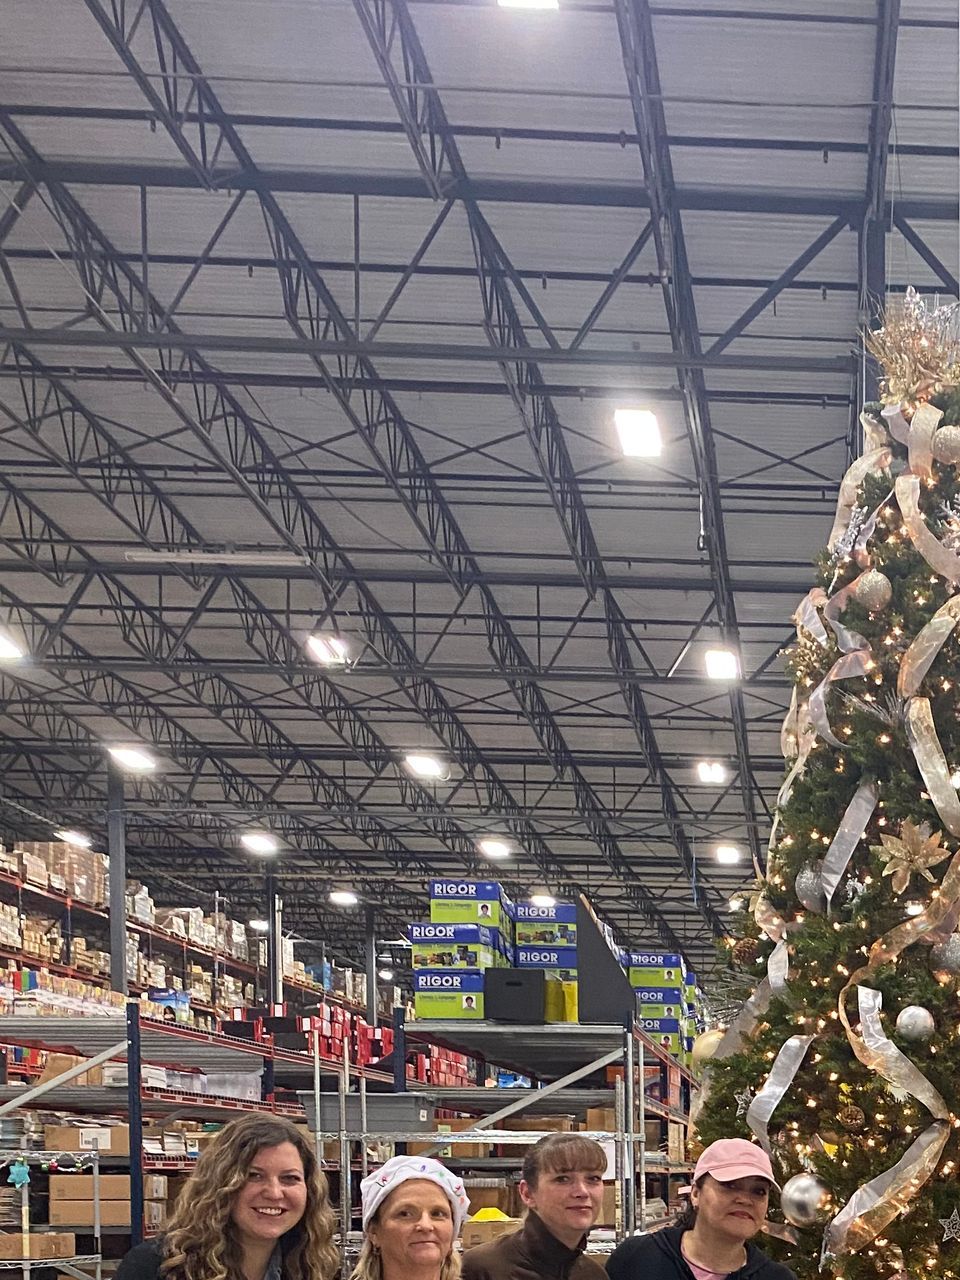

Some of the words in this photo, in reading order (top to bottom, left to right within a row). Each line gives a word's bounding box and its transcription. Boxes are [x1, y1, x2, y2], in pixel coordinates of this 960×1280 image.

[434, 883, 477, 895] RIGOR
[517, 907, 556, 917] RIGOR
[412, 926, 455, 937] RIGOR
[519, 952, 558, 962] RIGOR
[631, 955, 664, 964] RIGOR
[418, 976, 461, 987] RIGOR
